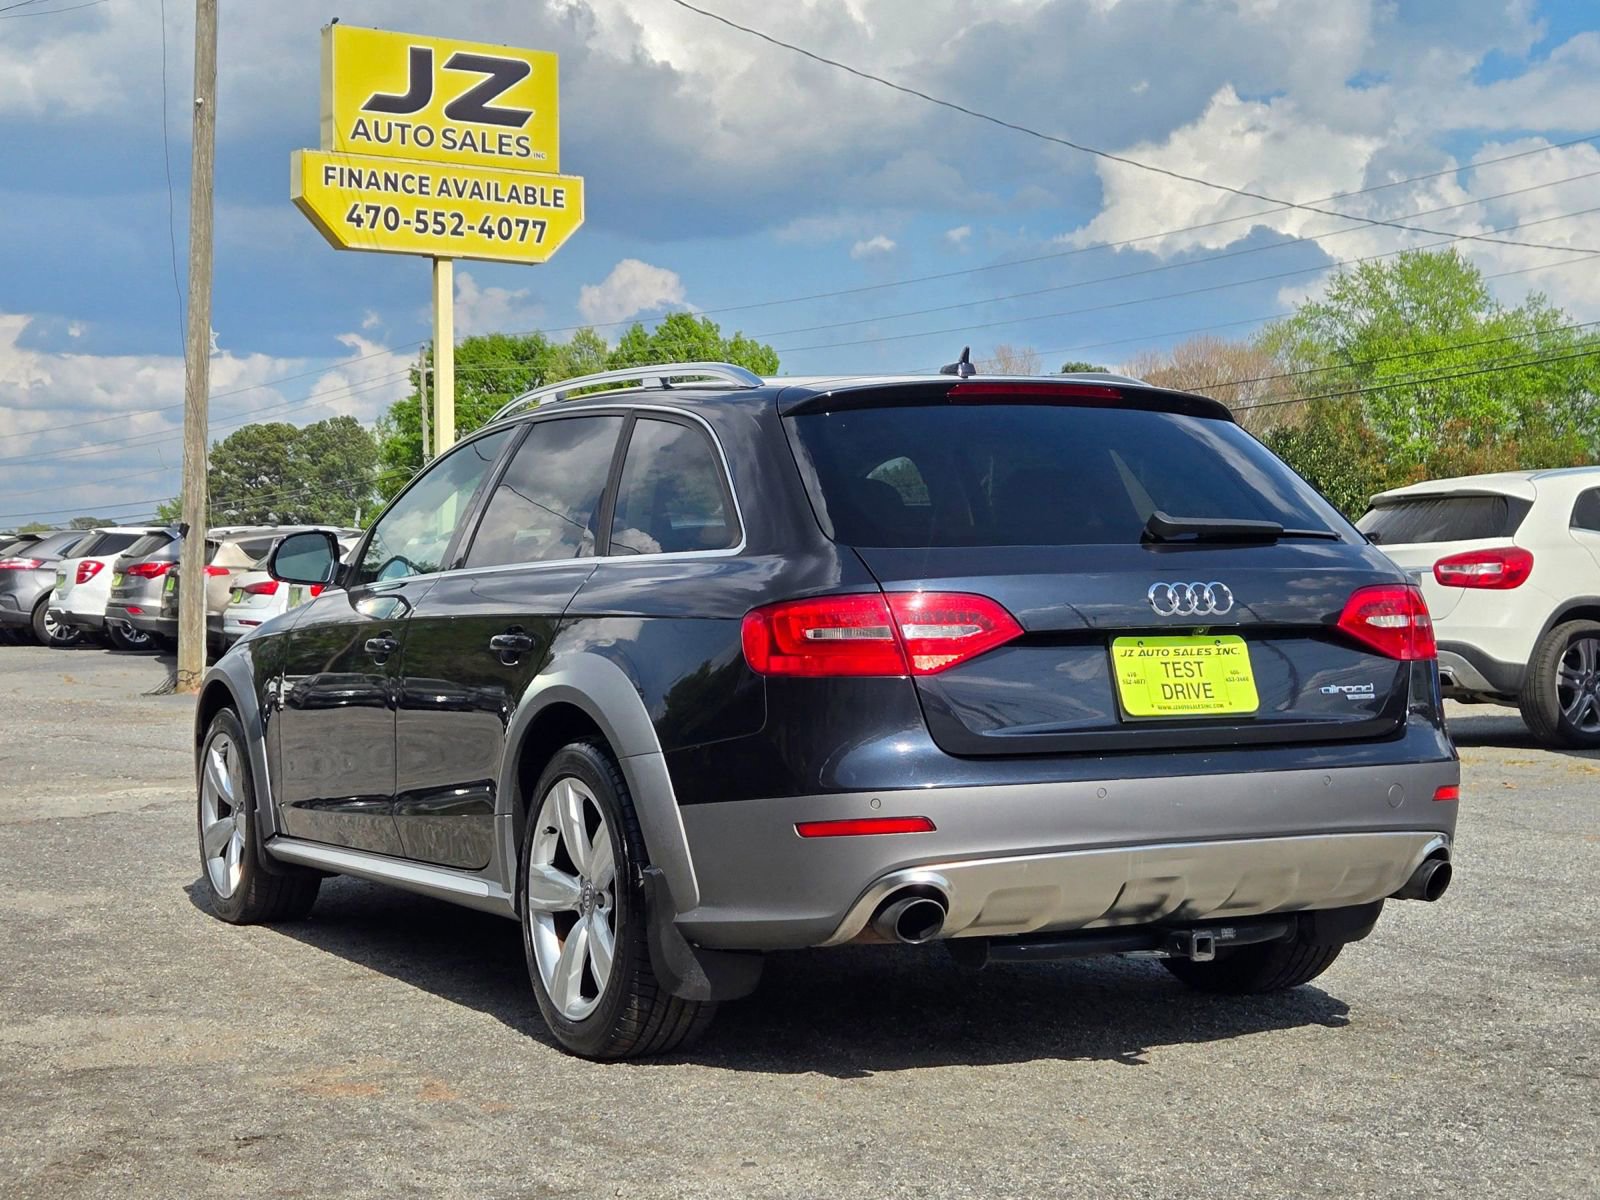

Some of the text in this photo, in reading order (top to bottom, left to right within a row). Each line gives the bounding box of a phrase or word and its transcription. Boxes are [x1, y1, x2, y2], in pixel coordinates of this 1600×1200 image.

[360, 46, 534, 128] JZ
[350, 118, 435, 148] AUTO
[441, 127, 531, 158] SALES
[323, 166, 565, 209] FINANCE AVAILABLE
[346, 203, 547, 243] 470-552-4077
[1120, 647, 1241, 657] JZ AUTO SALES INC.
[1160, 660, 1204, 679] TEST
[1161, 682, 1215, 700] DRIVE
